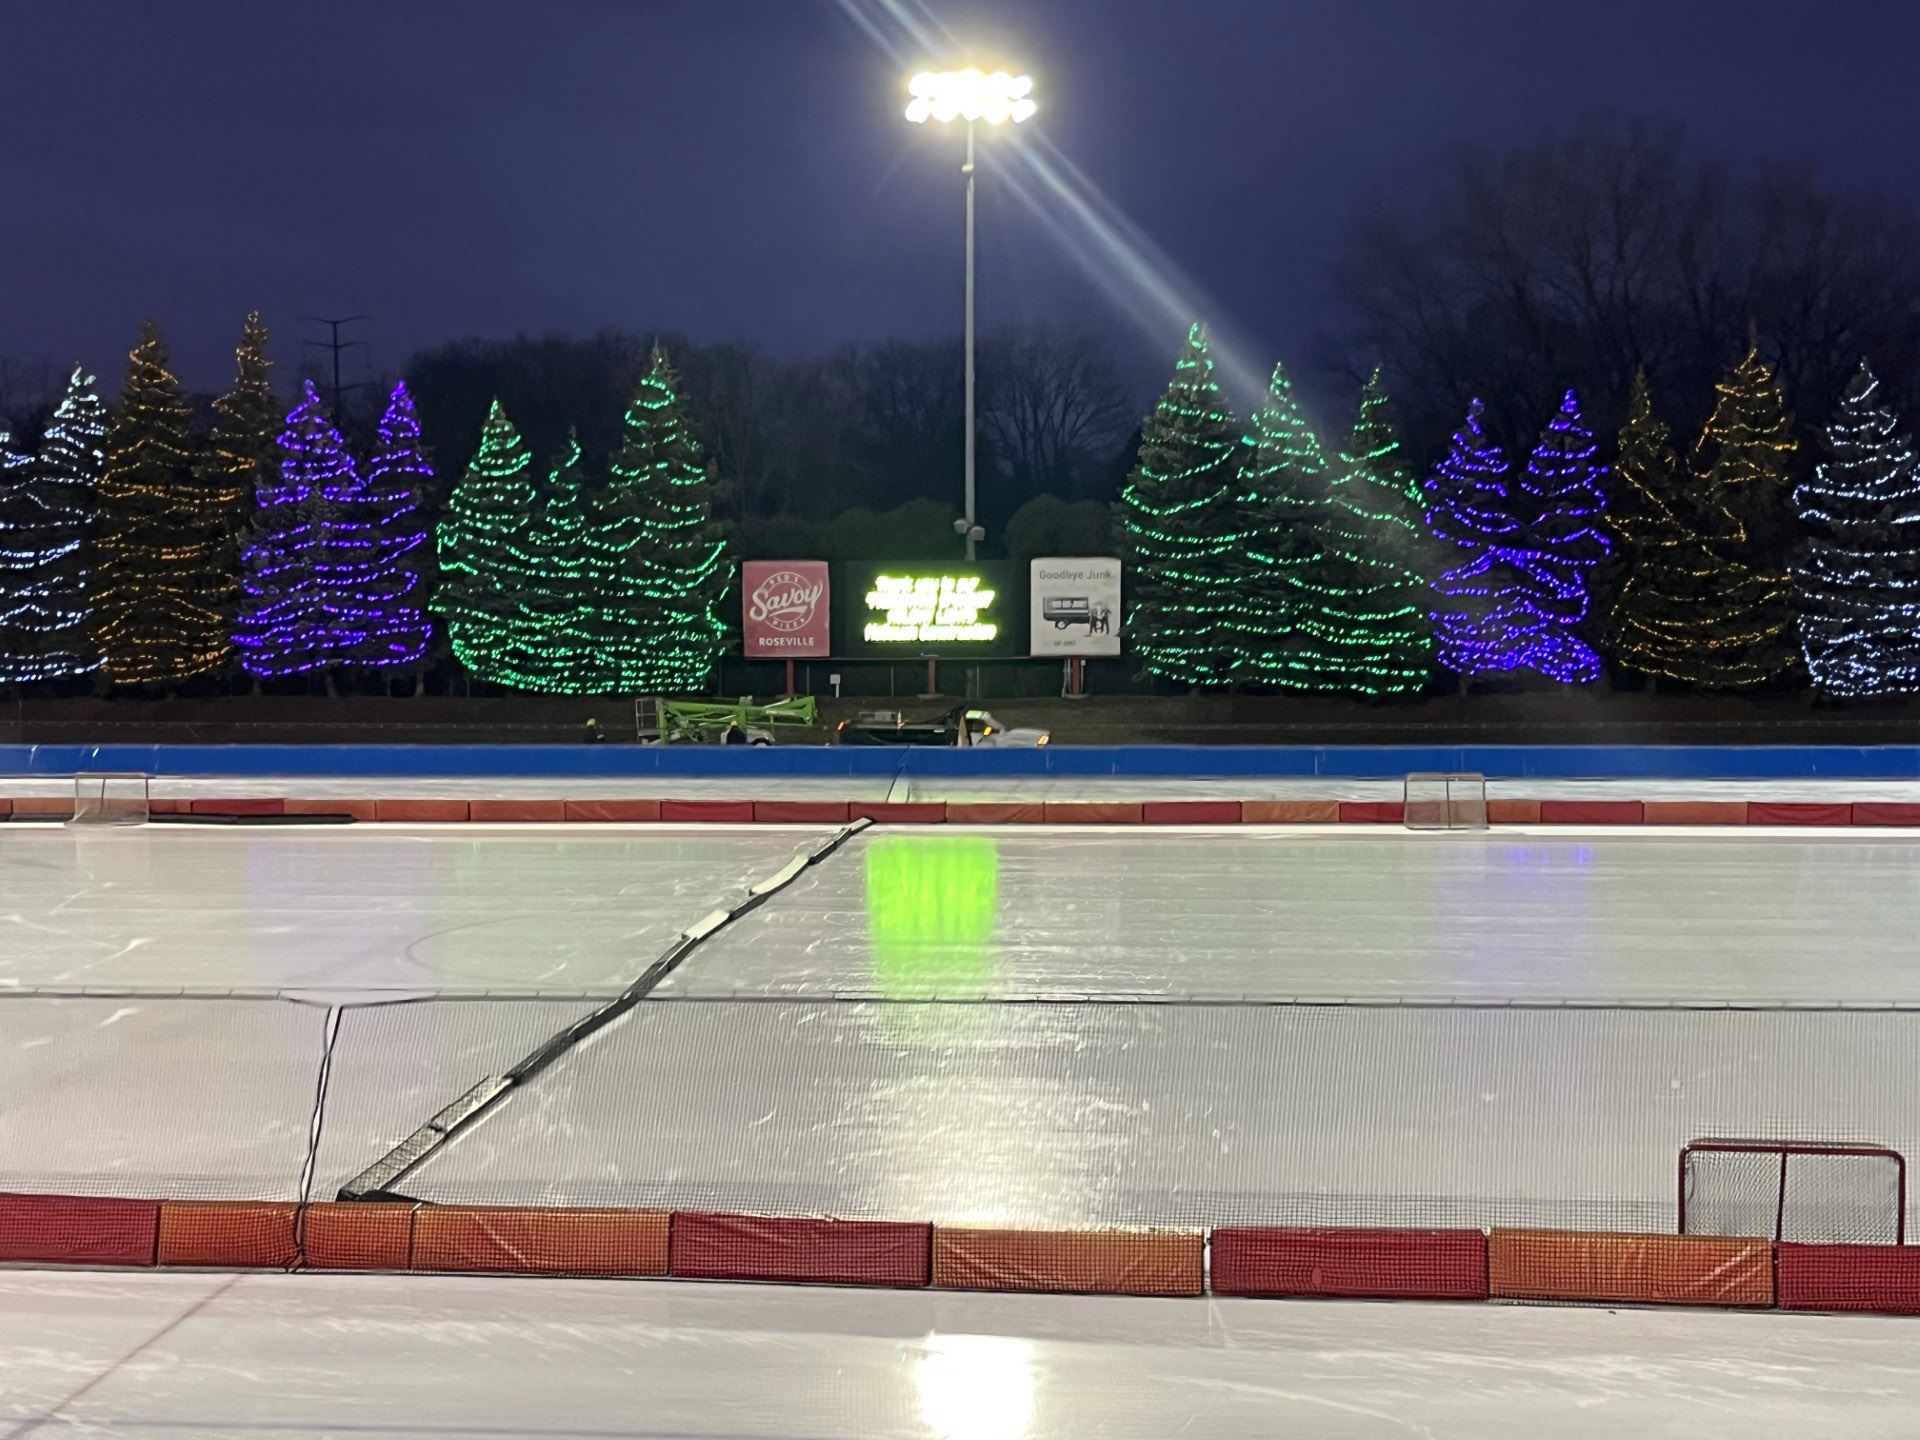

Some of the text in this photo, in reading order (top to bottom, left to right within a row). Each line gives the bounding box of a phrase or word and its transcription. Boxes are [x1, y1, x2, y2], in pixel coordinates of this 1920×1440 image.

[1039, 570, 1083, 581] Goodbye
[749, 580, 823, 621] Savoy
[759, 637, 814, 647] ROSEVILLE
